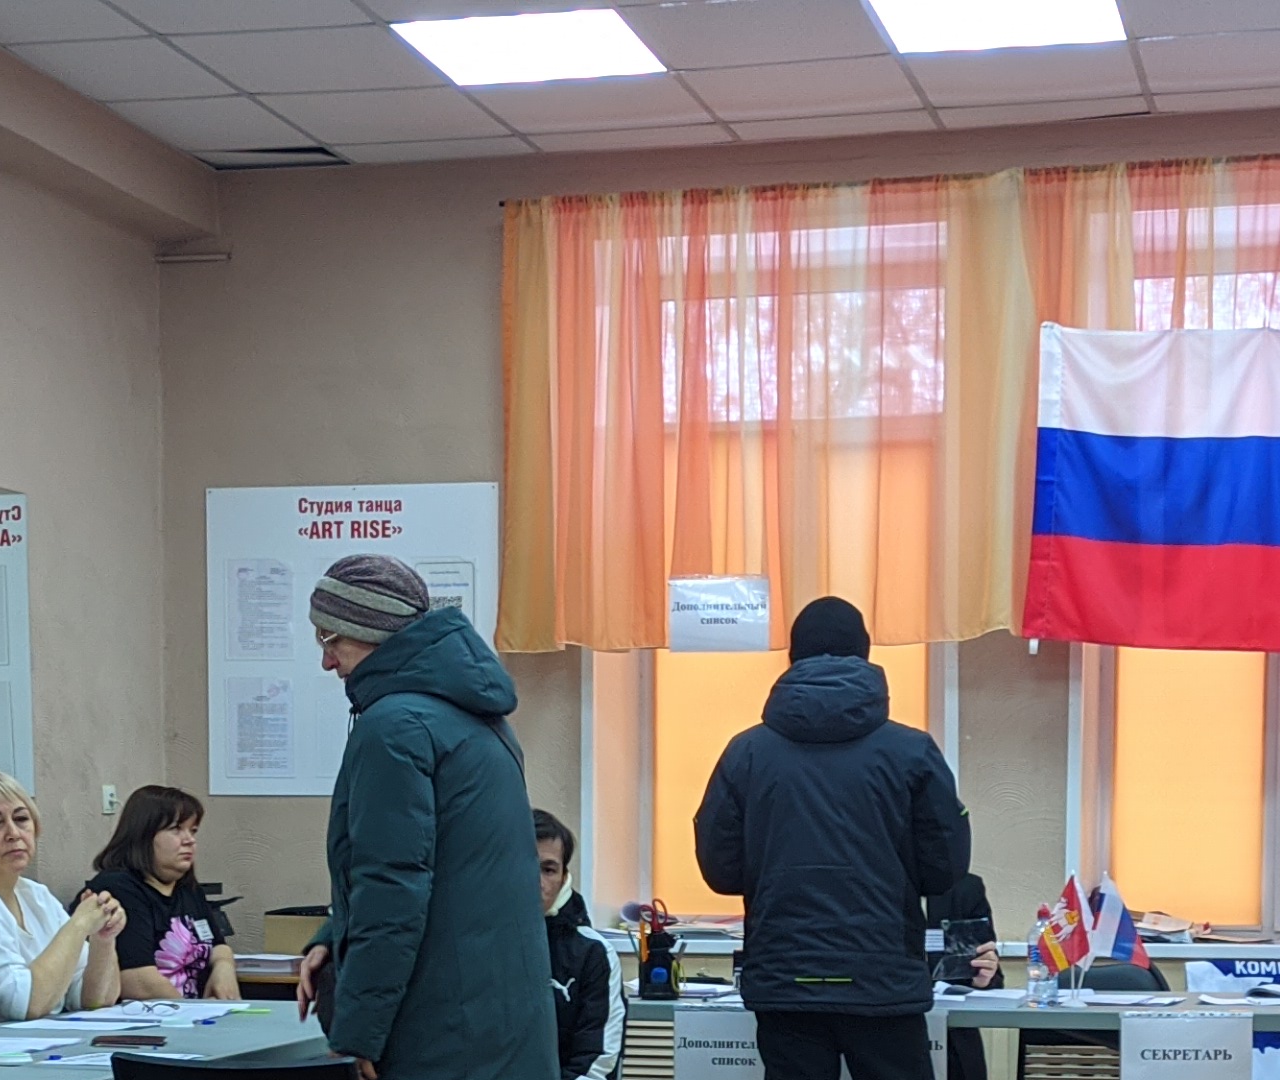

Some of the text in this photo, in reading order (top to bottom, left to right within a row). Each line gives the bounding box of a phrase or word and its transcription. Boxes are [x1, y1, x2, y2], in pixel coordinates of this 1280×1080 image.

[298, 497, 403, 516] Студия танца
[298, 520, 403, 539] «ART RISE»
[700, 617, 738, 625] список
[677, 1036, 758, 1050] Дополнител
[711, 1055, 757, 1067] список
[1140, 1048, 1232, 1061] СЕКРЕТАРЬ
